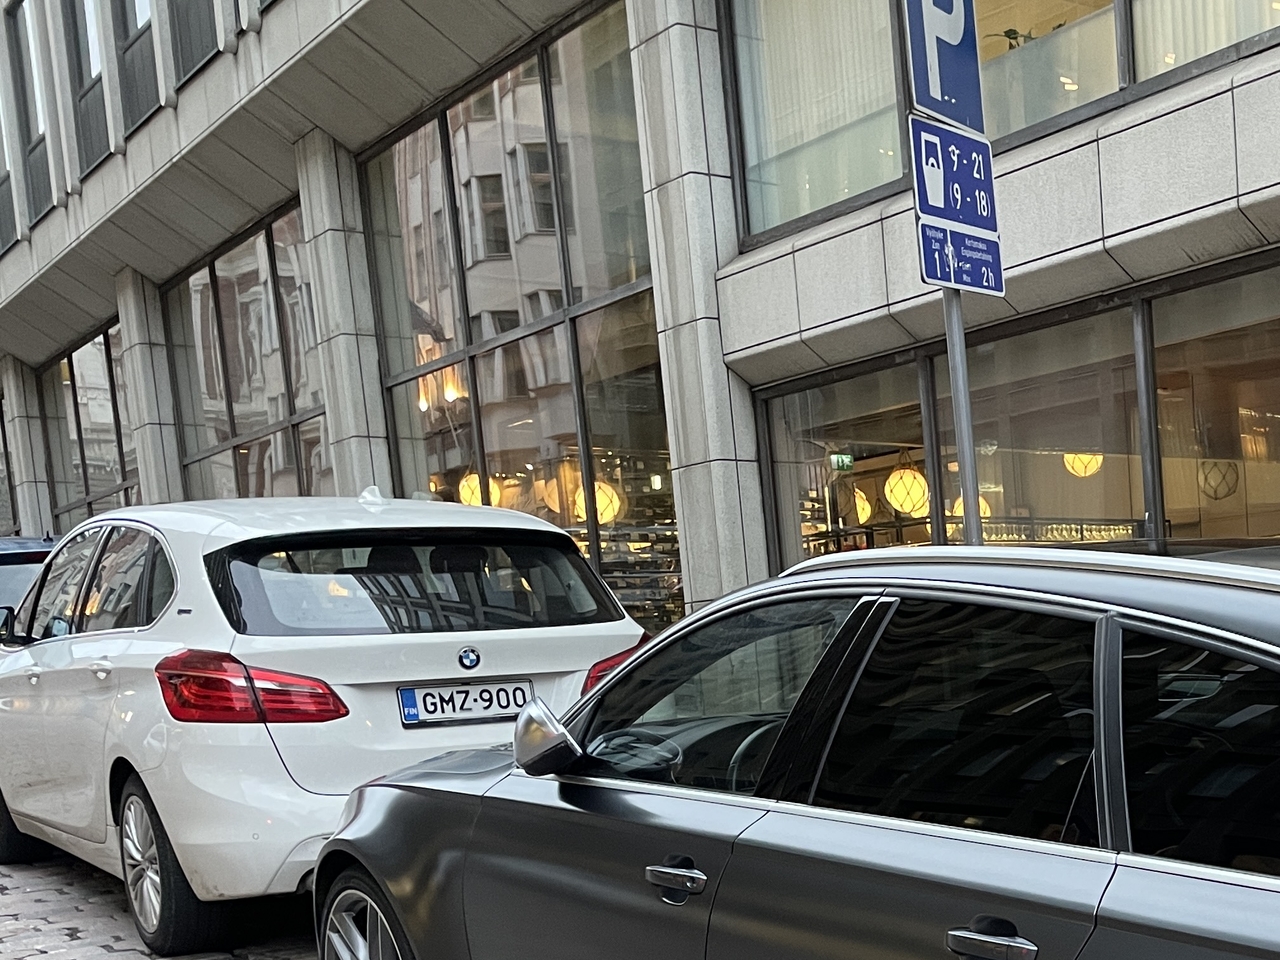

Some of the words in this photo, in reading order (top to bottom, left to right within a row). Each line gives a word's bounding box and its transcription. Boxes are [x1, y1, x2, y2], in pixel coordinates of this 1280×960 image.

[922, 0, 965, 101] P
[949, 145, 960, 171] 9
[972, 152, 984, 180] 21
[949, 182, 961, 209] (9
[975, 189, 991, 217] 18)
[934, 251, 941, 278] 1
[404, 707, 417, 716] FIN
[423, 687, 527, 714] GMZ-900
